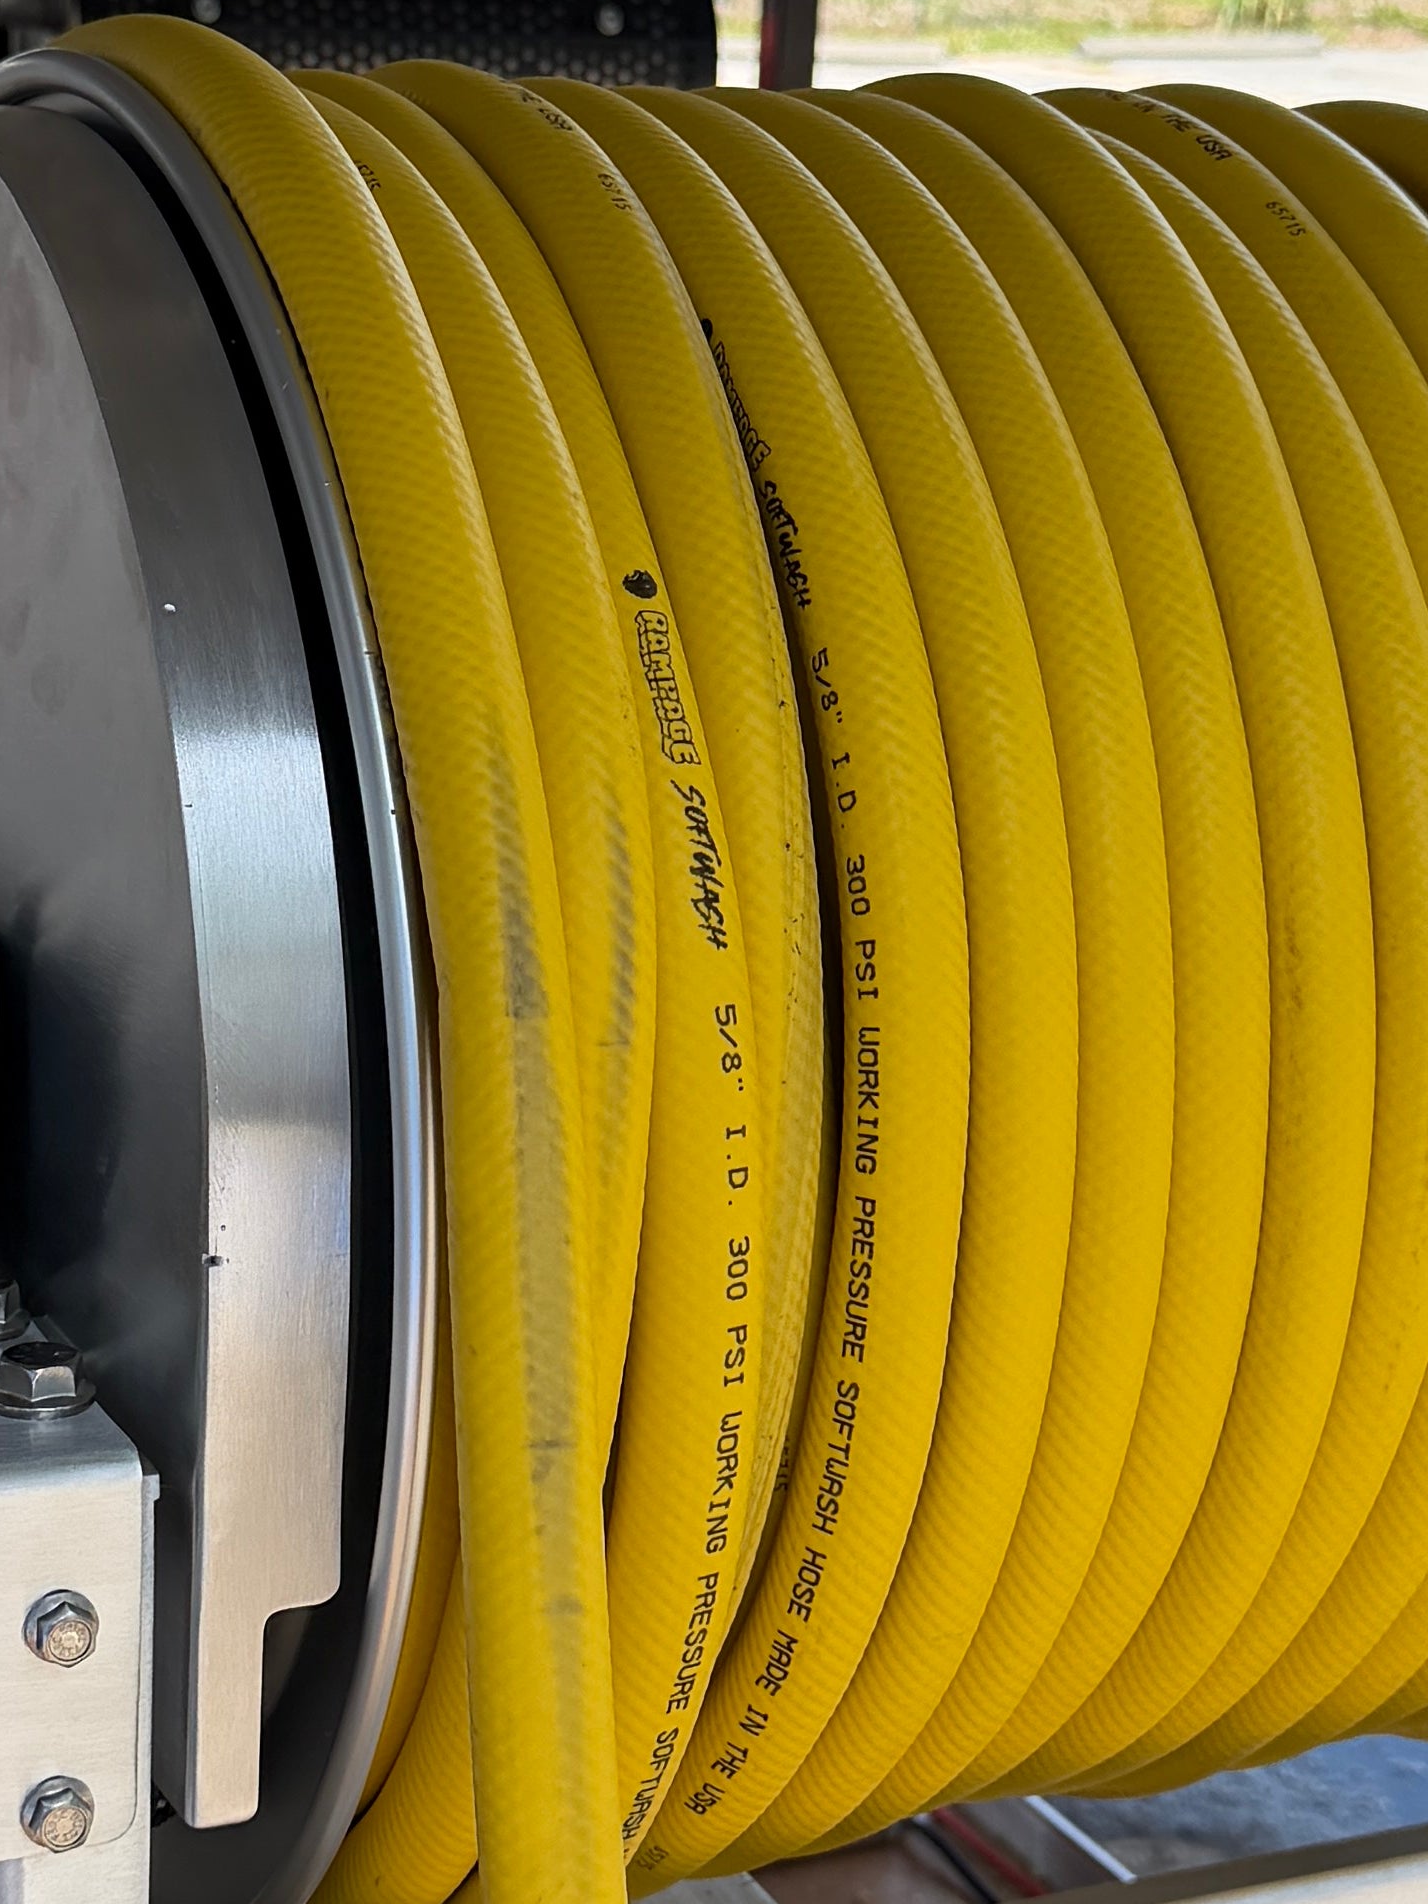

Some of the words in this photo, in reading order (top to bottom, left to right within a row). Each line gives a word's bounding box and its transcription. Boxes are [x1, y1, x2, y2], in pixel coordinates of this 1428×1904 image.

[1195, 134, 1233, 161] USA
[635, 610, 700, 766] RAMPAGE
[811, 647, 843, 726] 5/8"
[832, 752, 857, 830] I.D.
[671, 780, 727, 951] SOFTWASH
[846, 854, 870, 916] 300
[855, 938, 877, 1001] PSI
[714, 1003, 744, 1093] 5/8"
[854, 1027, 881, 1176] WORKING
[725, 1124, 749, 1206] I.D.
[726, 1235, 750, 1300] 300
[841, 1196, 877, 1363] PRESSURE
[722, 1324, 748, 1387] PSI
[704, 1410, 741, 1555] WORKING
[812, 1380, 859, 1536] SOFTWASH
[787, 1546, 827, 1622] HOSE
[665, 1572, 719, 1713] PRESSURE
[755, 1629, 798, 1696] MADE
[738, 1704, 771, 1738] IN
[622, 1727, 679, 1839] SOFTWASH
[684, 1783, 725, 1815] USA
[710, 1741, 748, 1780] THE
